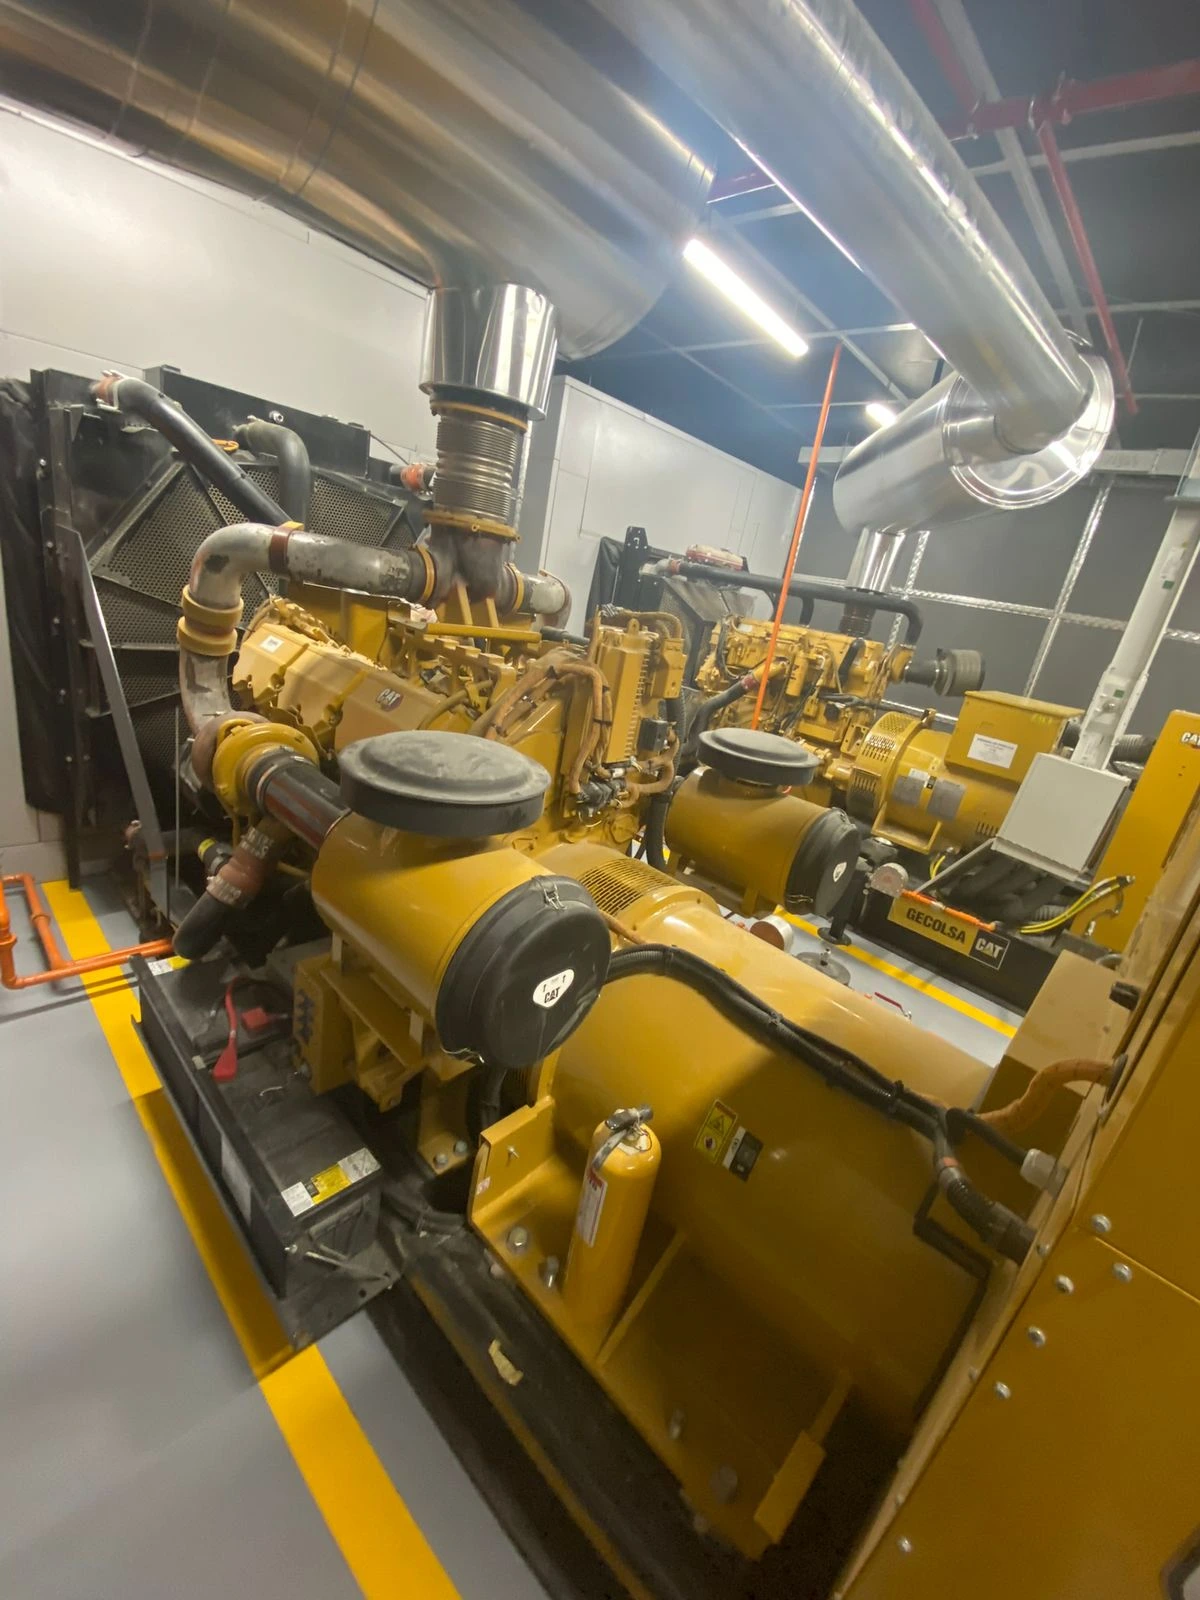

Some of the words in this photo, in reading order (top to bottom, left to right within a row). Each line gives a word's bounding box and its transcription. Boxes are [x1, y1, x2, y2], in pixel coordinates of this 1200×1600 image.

[377, 688, 401, 705] CAT
[906, 907, 967, 945] GECOLSA
[975, 938, 1003, 959] CAT
[544, 986, 561, 1004] CAT
